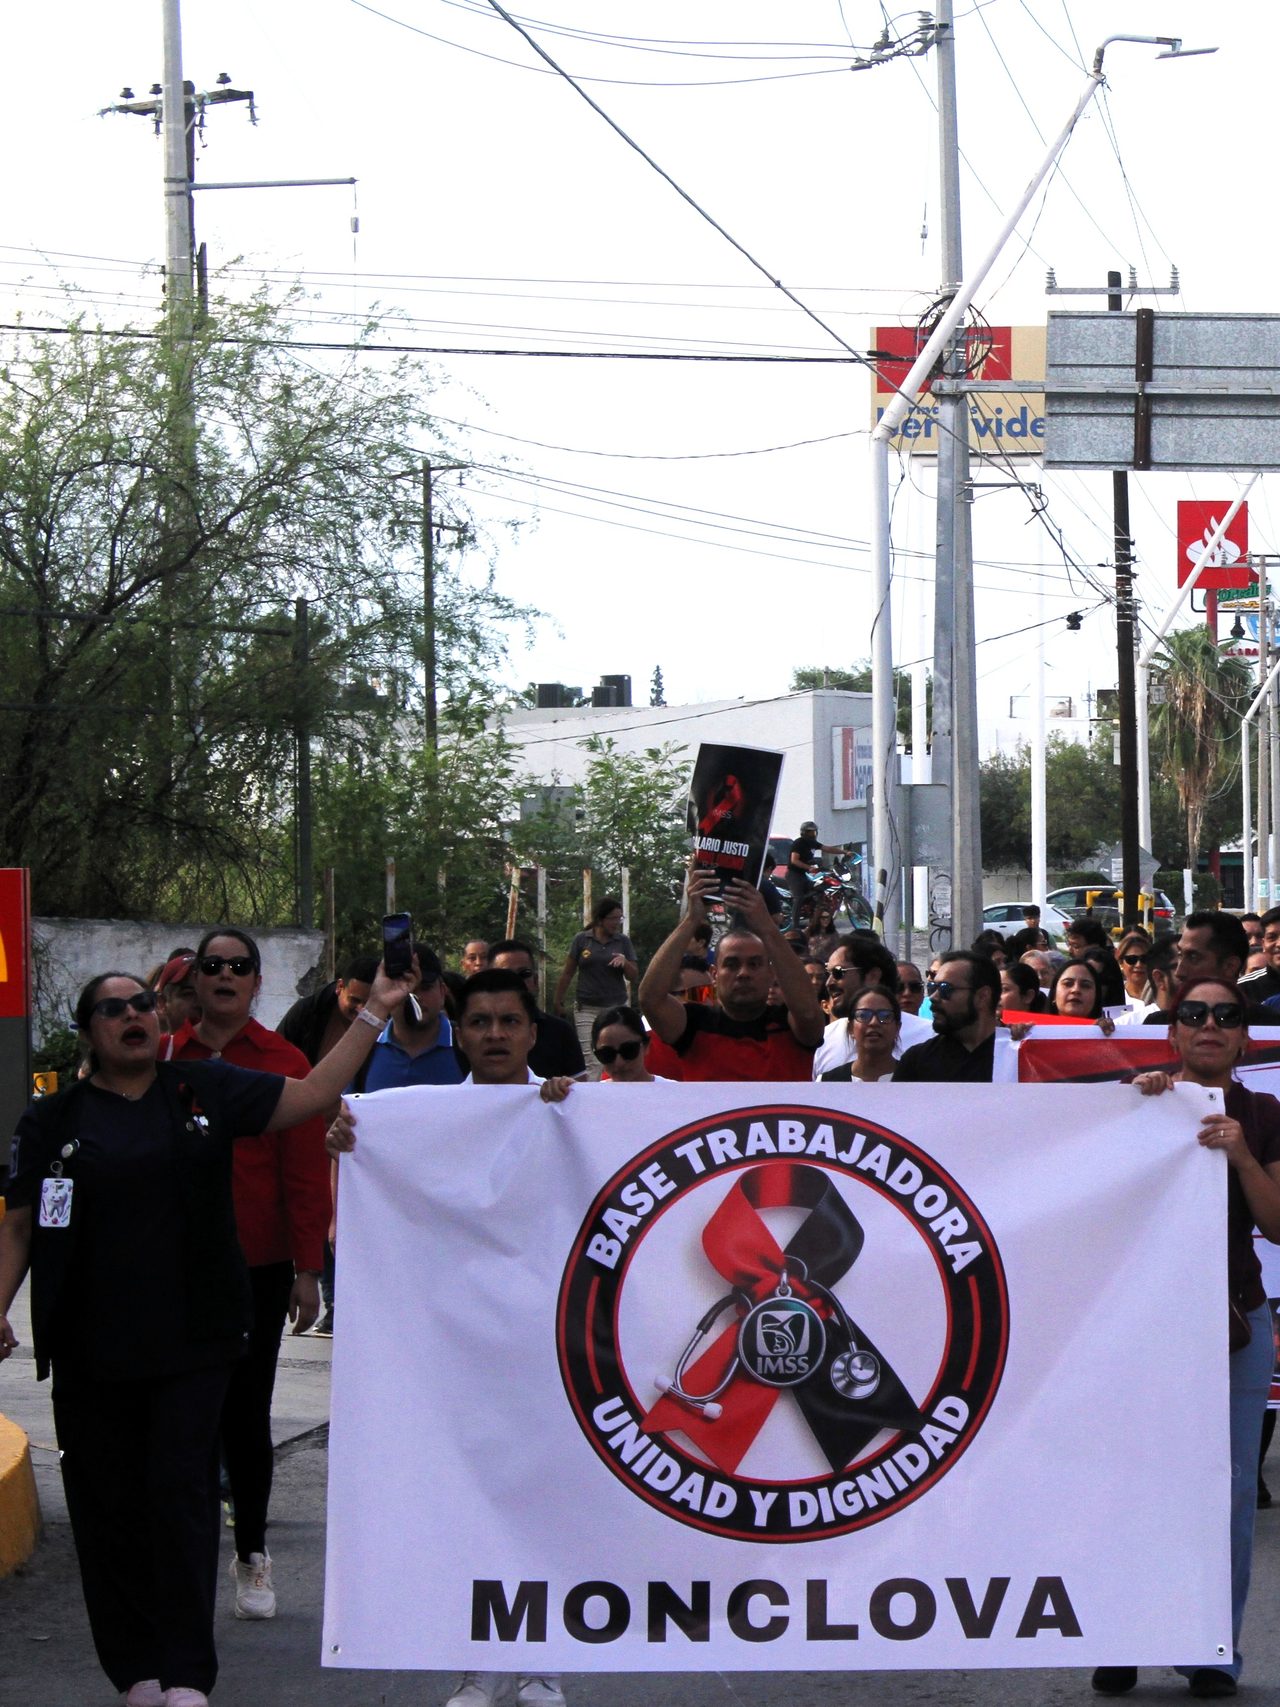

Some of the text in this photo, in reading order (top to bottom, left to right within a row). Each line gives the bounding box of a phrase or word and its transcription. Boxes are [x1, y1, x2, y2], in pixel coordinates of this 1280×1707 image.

[721, 840, 749, 857] JUSTO
[586, 1120, 983, 1274] BASE TRABAJADORA
[757, 1356, 809, 1374] IMSS
[592, 1395, 971, 1528] UNIDAD Y DIGNIDAD
[470, 1576, 1083, 1644] MONCLOVA
